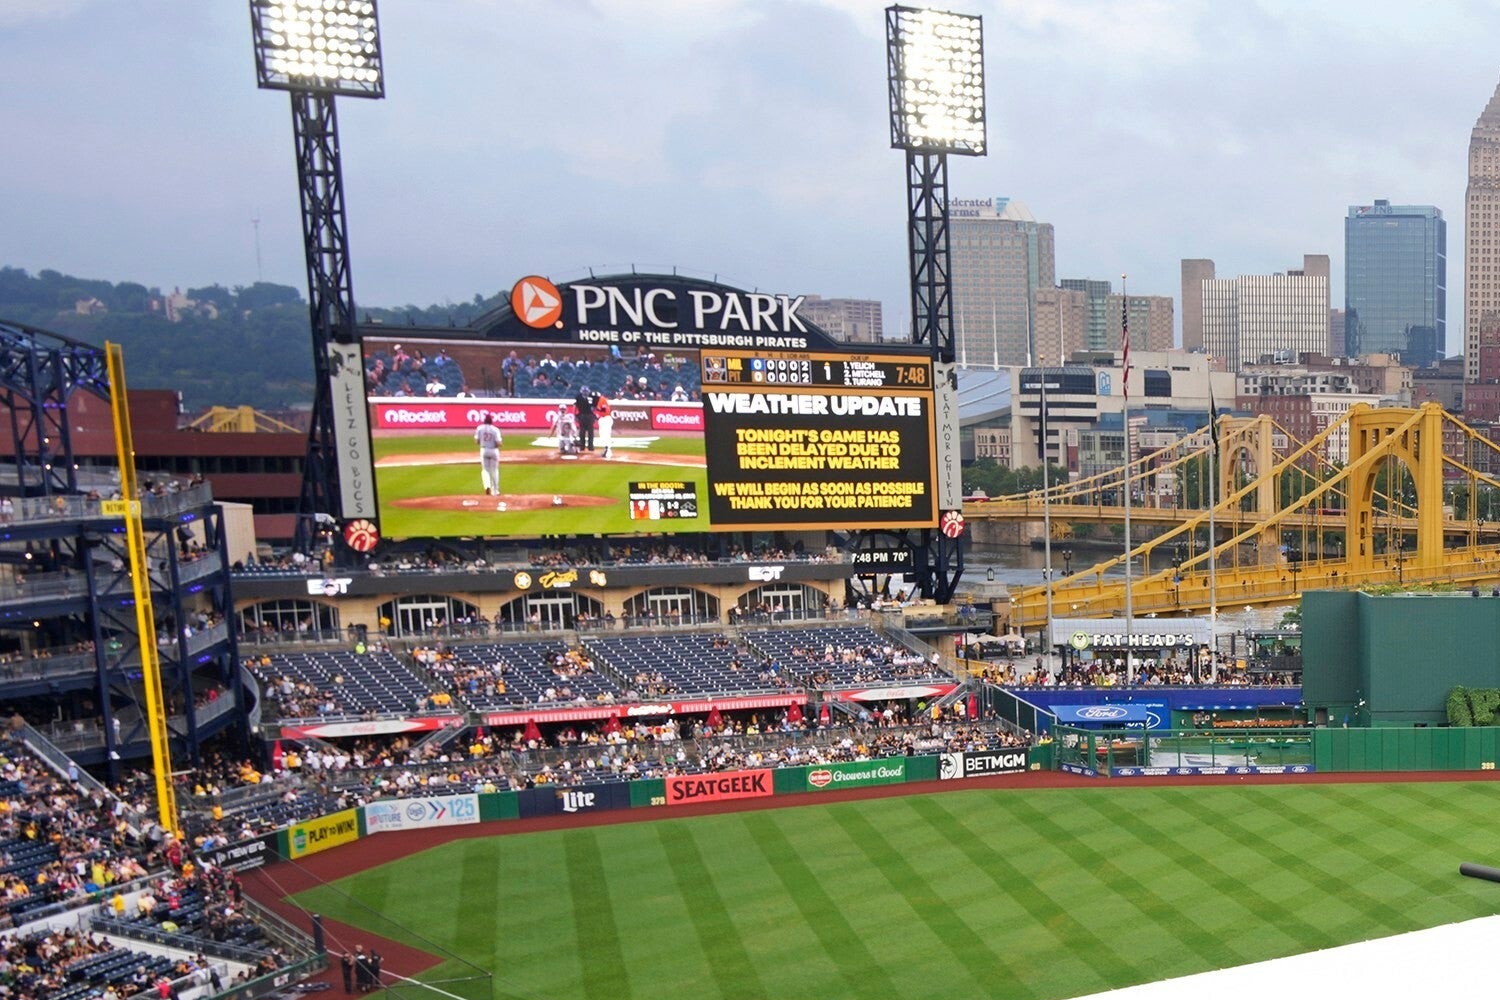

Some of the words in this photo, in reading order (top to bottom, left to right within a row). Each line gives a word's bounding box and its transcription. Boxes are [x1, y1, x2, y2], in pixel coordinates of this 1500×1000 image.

[570, 285, 678, 328] PNC
[688, 290, 807, 333] PARK
[579, 329, 619, 341] HOME
[622, 331, 641, 343] OF
[644, 331, 670, 344] THE
[673, 332, 752, 346] PITTSBURGH
[756, 335, 807, 348] PIRATES
[728, 371, 741, 382] PIT
[896, 366, 926, 384] 7:48
[345, 382, 357, 430] LETZ
[708, 393, 829, 416] WEATHER
[831, 395, 921, 417] UPDATE
[942, 393, 950, 419] EAT
[398, 408, 447, 421] Rocket
[664, 413, 700, 424] Rocket
[736, 429, 819, 443] TONIGHT'S
[820, 429, 867, 443] GAME
[868, 430, 900, 443] HAS
[942, 424, 952, 450] MOR
[348, 436, 360, 460] GO
[737, 443, 777, 456] BEEN
[779, 443, 848, 456] DELAYED
[849, 443, 881, 456] DUE
[881, 443, 900, 456] TO
[740, 457, 827, 470] INCLEMENT
[827, 457, 900, 470] WEATHER
[351, 466, 364, 513] BUCS
[714, 483, 736, 496] WE
[736, 483, 764, 496] WILL
[765, 483, 801, 496] BEGIN
[802, 483, 819, 495] AS
[819, 483, 854, 495] SOON
[855, 483, 872, 495] AS
[872, 482, 925, 495] POSSIBLE
[730, 496, 773, 509] THANK
[774, 496, 800, 509] YOU
[801, 496, 823, 509] FOR
[824, 496, 856, 508] YOUR
[857, 496, 912, 508] PATIENCE
[873, 552, 889, 562] PM
[1093, 634, 1123, 647] FAT
[1128, 634, 1194, 647] HEAD'S
[1085, 706, 1118, 718] Ford
[966, 753, 1026, 771] BETMGM
[833, 770, 871, 783] Growers
[877, 766, 903, 779] Good
[672, 773, 767, 800] SEATGEEK
[450, 798, 475, 818] 125
[561, 791, 595, 812] Lite
[309, 829, 328, 843] PLAY
[336, 819, 355, 834] WIN!
